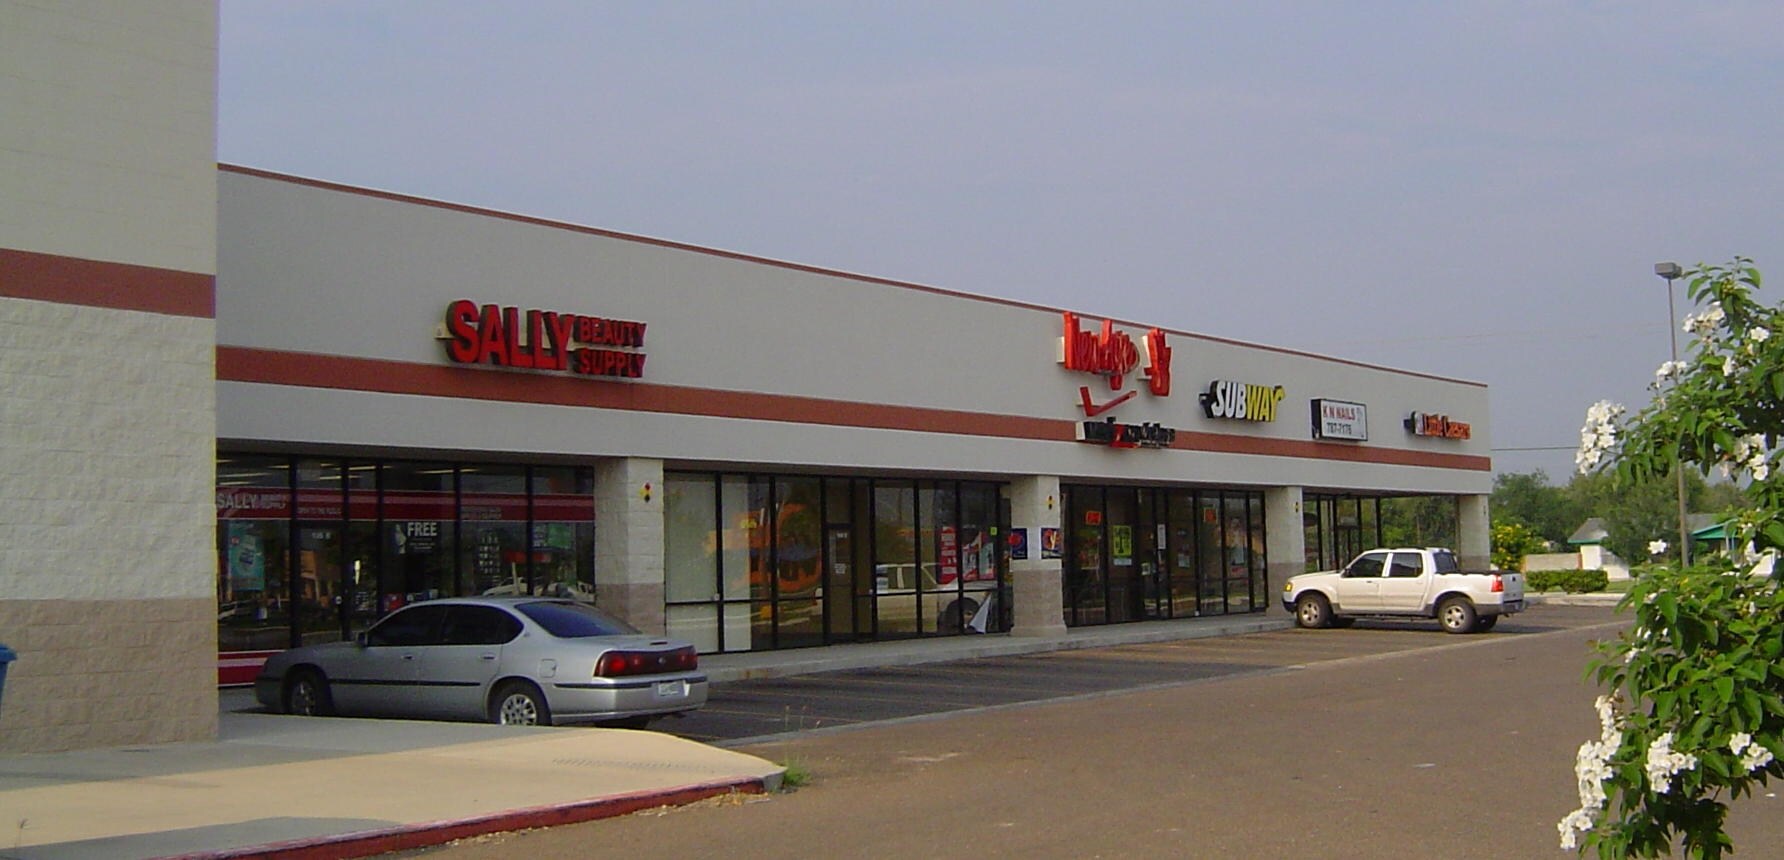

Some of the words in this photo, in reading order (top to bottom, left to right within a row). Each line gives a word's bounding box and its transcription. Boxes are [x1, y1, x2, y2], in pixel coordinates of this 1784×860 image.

[447, 299, 575, 371] SALLY
[574, 315, 647, 348] BEAUTY
[574, 347, 647, 378] SUPPLY
[1210, 380, 1286, 422] SUBWAY
[1336, 406, 1356, 421] NAILS
[216, 492, 258, 509] SALLY
[407, 522, 438, 537] FREE
